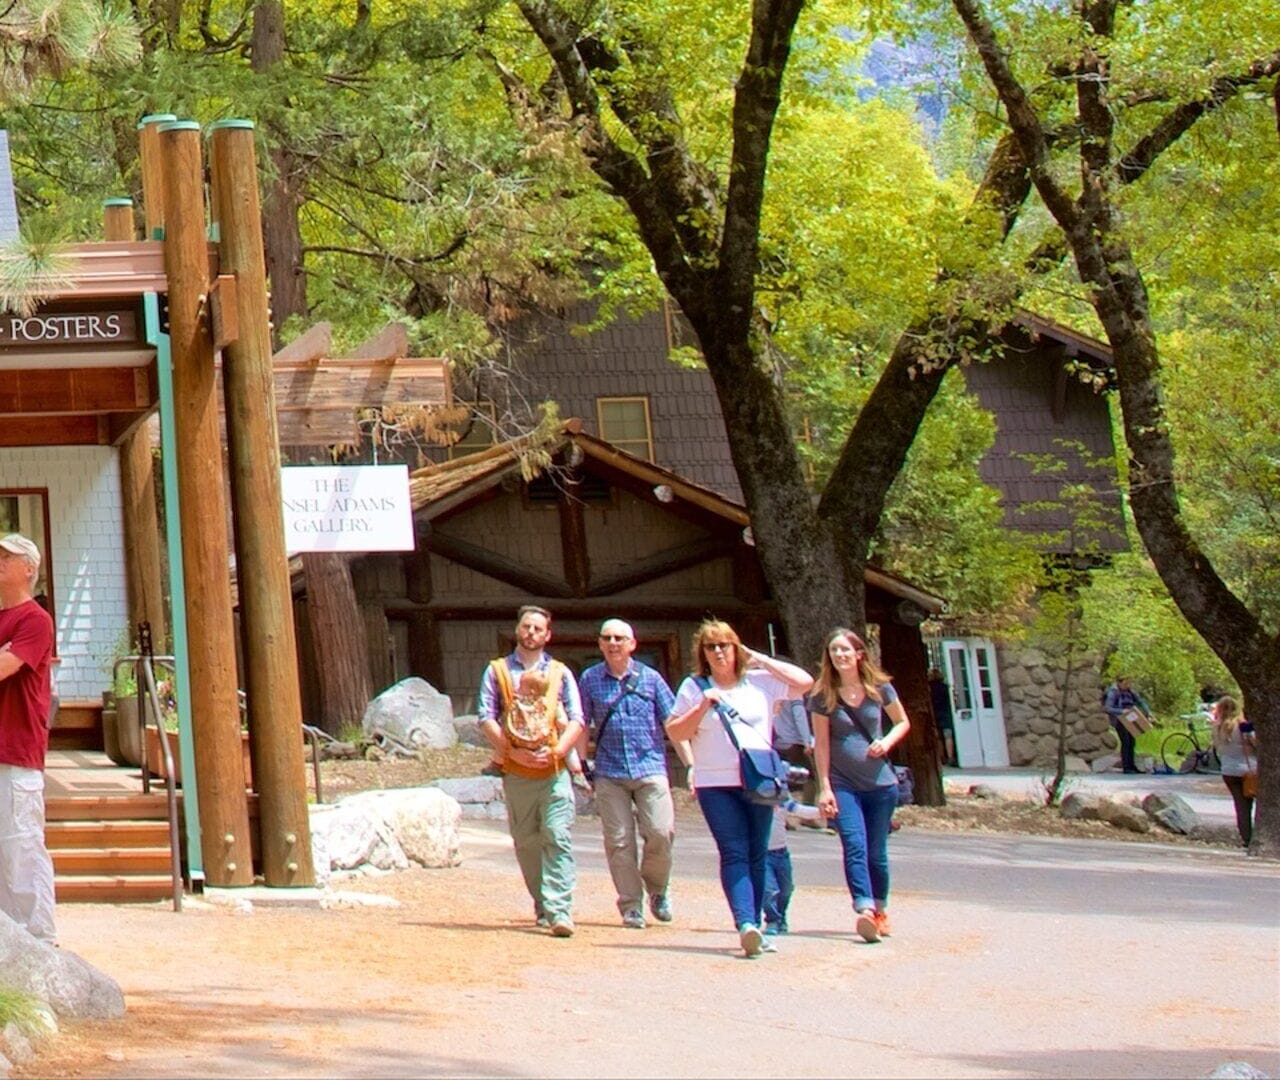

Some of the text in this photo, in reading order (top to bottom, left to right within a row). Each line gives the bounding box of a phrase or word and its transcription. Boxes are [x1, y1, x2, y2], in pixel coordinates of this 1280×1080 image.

[11, 316, 120, 340] POSTERS
[313, 478, 350, 493] THE
[331, 496, 396, 512] ADAMS
